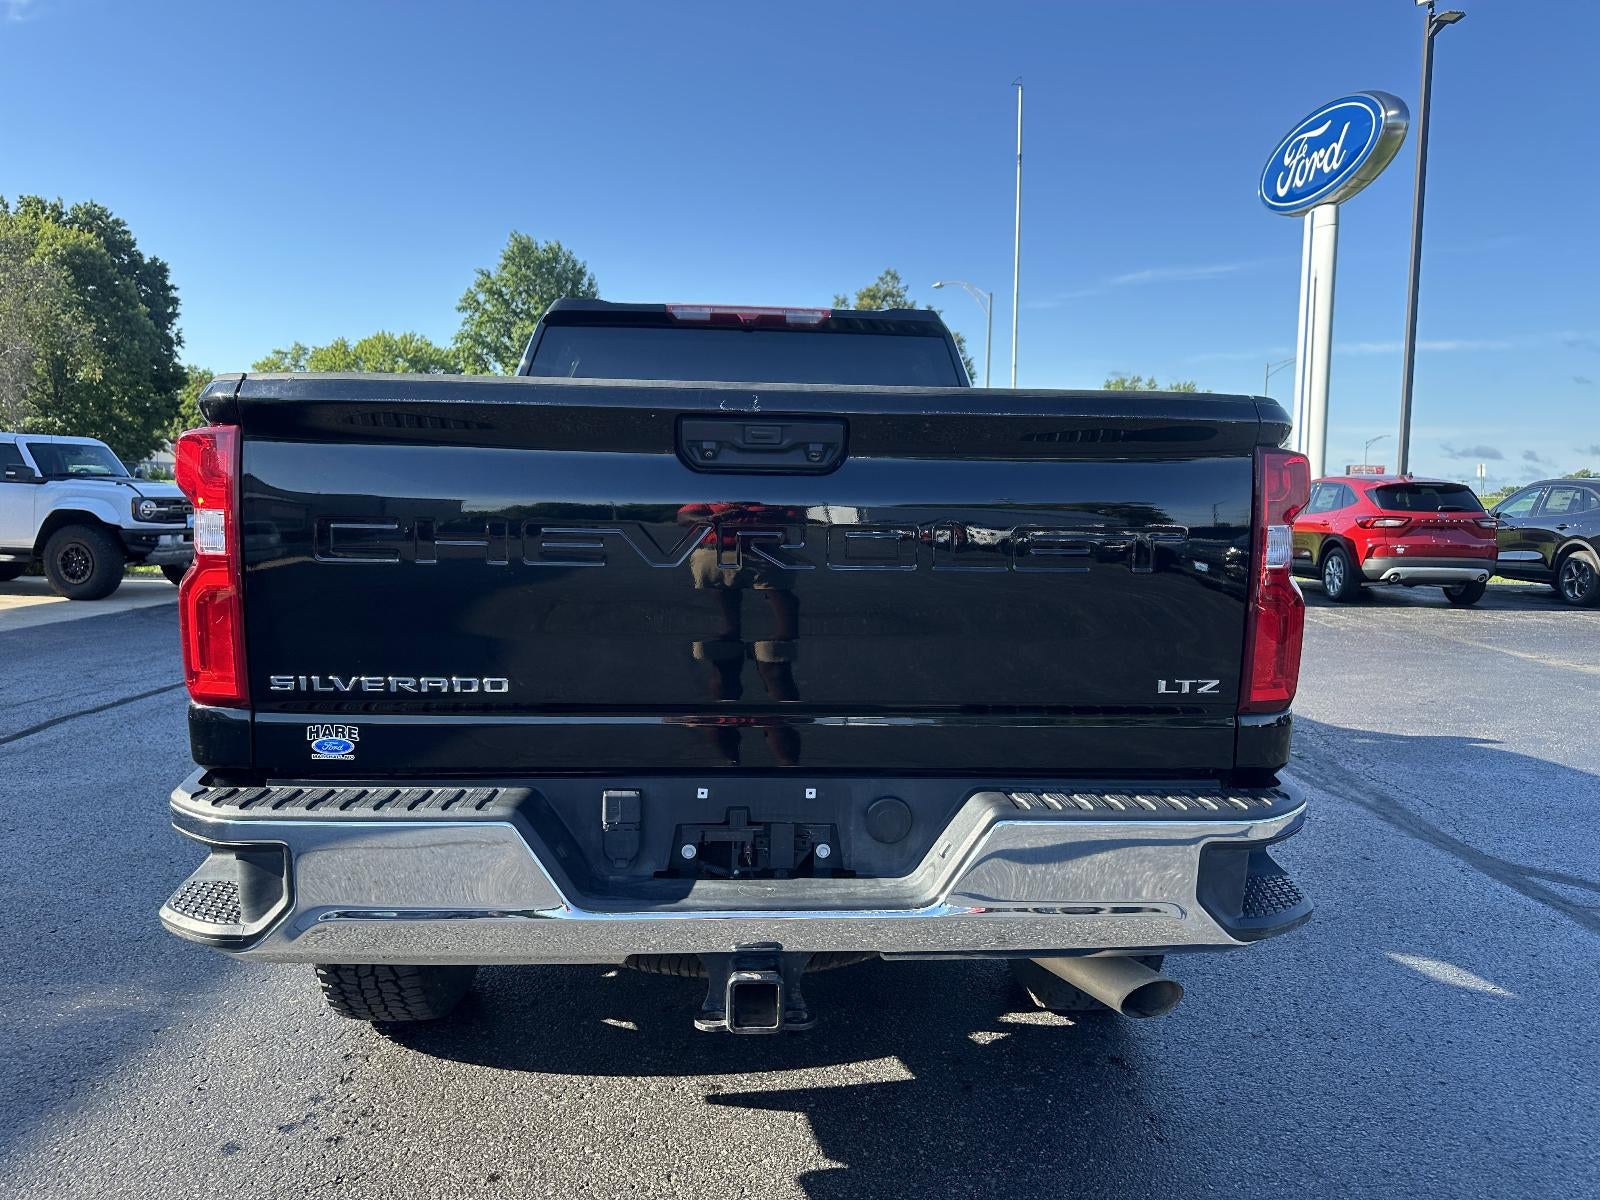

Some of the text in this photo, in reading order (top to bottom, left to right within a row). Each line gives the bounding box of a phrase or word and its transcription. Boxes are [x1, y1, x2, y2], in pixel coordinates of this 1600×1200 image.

[1276, 119, 1351, 198] Ford
[313, 515, 1189, 575] CHEVROLET
[269, 674, 510, 693] SILVERADO
[1157, 679, 1220, 694] LTZ
[306, 724, 360, 742] HARE
